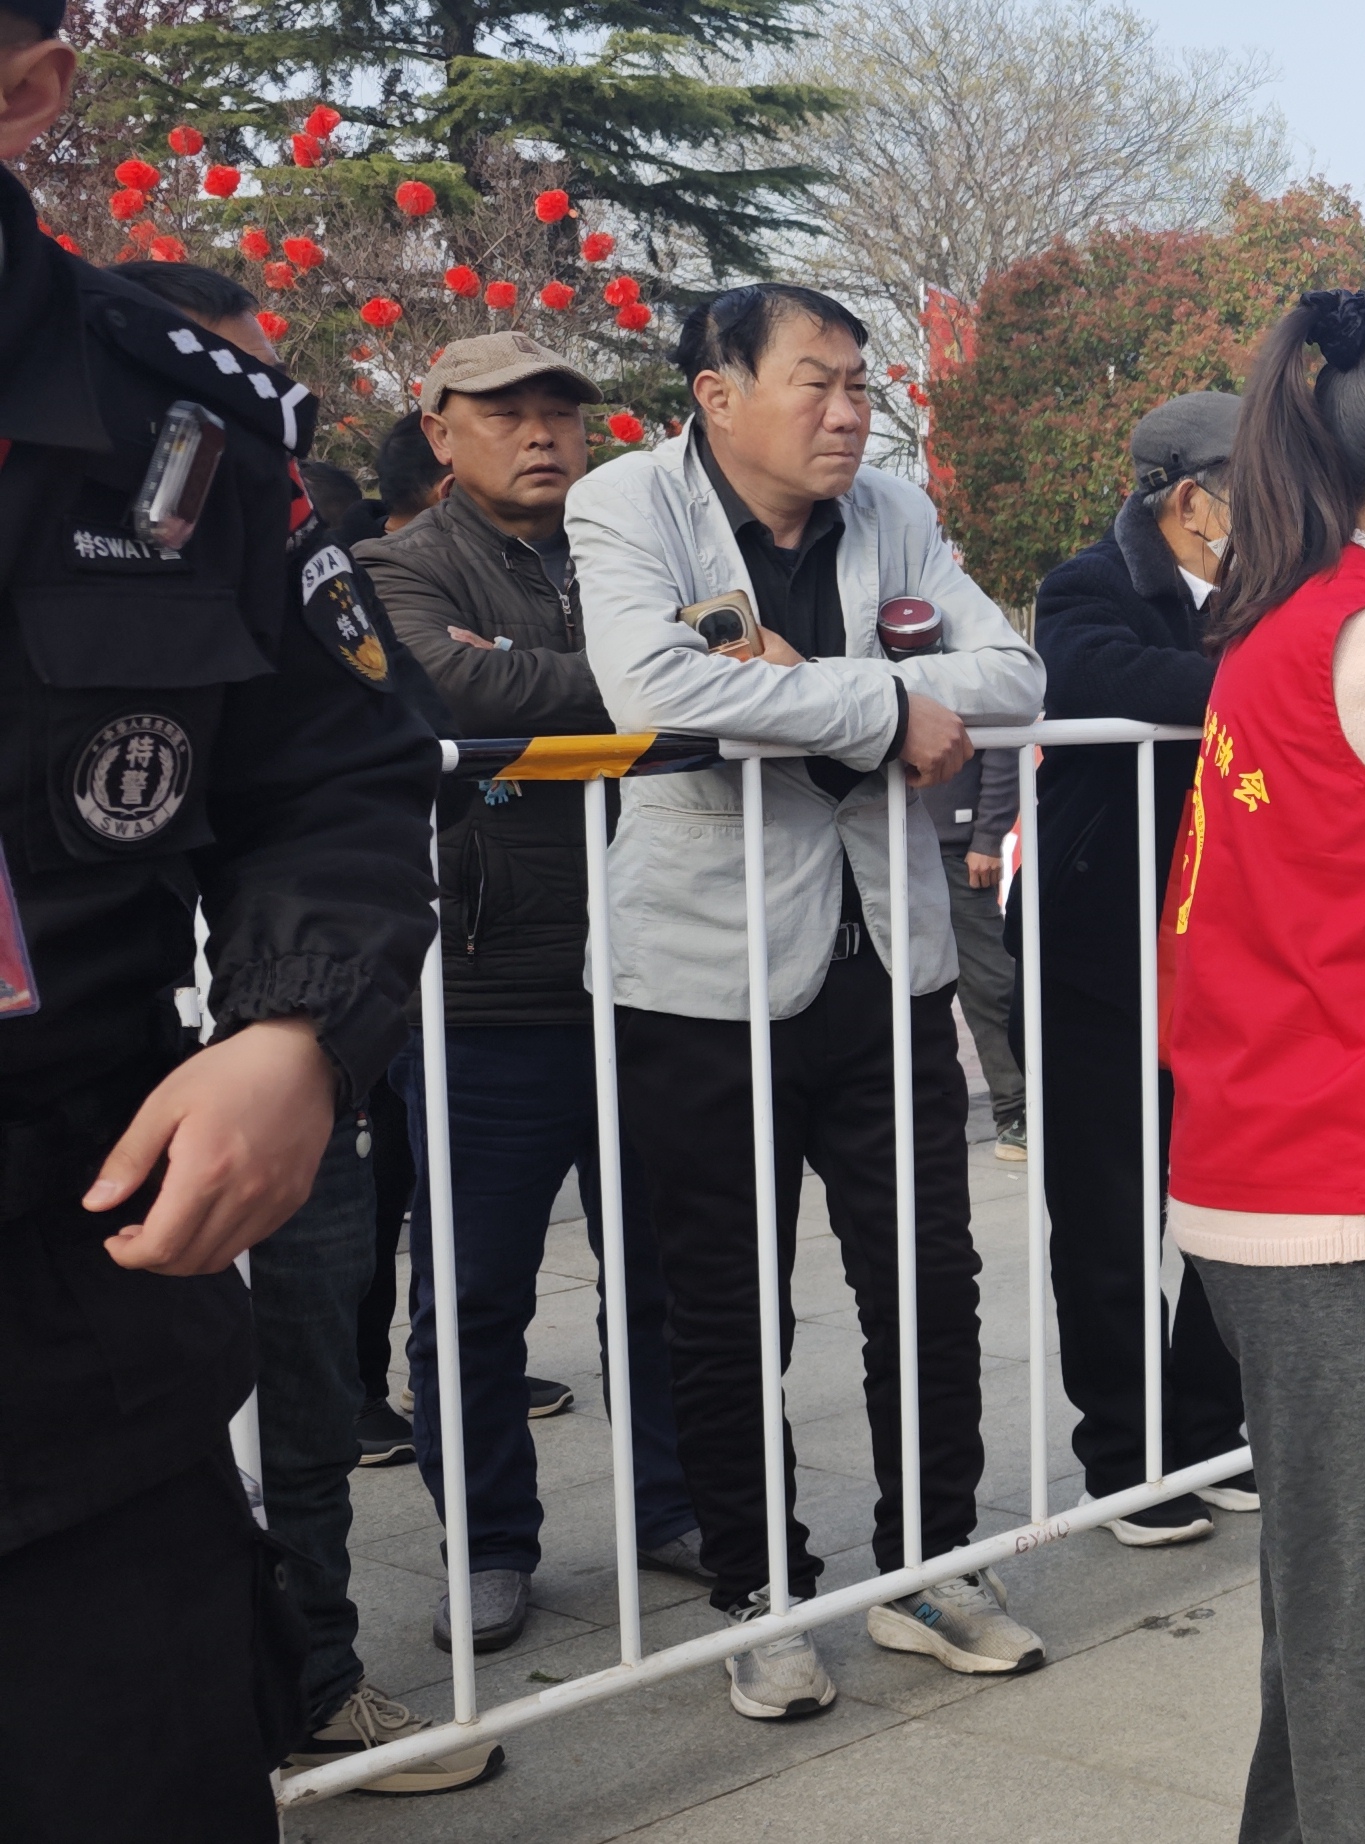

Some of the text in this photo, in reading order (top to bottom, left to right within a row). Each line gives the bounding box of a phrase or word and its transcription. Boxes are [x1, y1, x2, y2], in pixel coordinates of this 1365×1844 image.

[304, 549, 343, 588] SWA
[119, 735, 155, 805] 特警
[101, 816, 158, 837] SWAT
